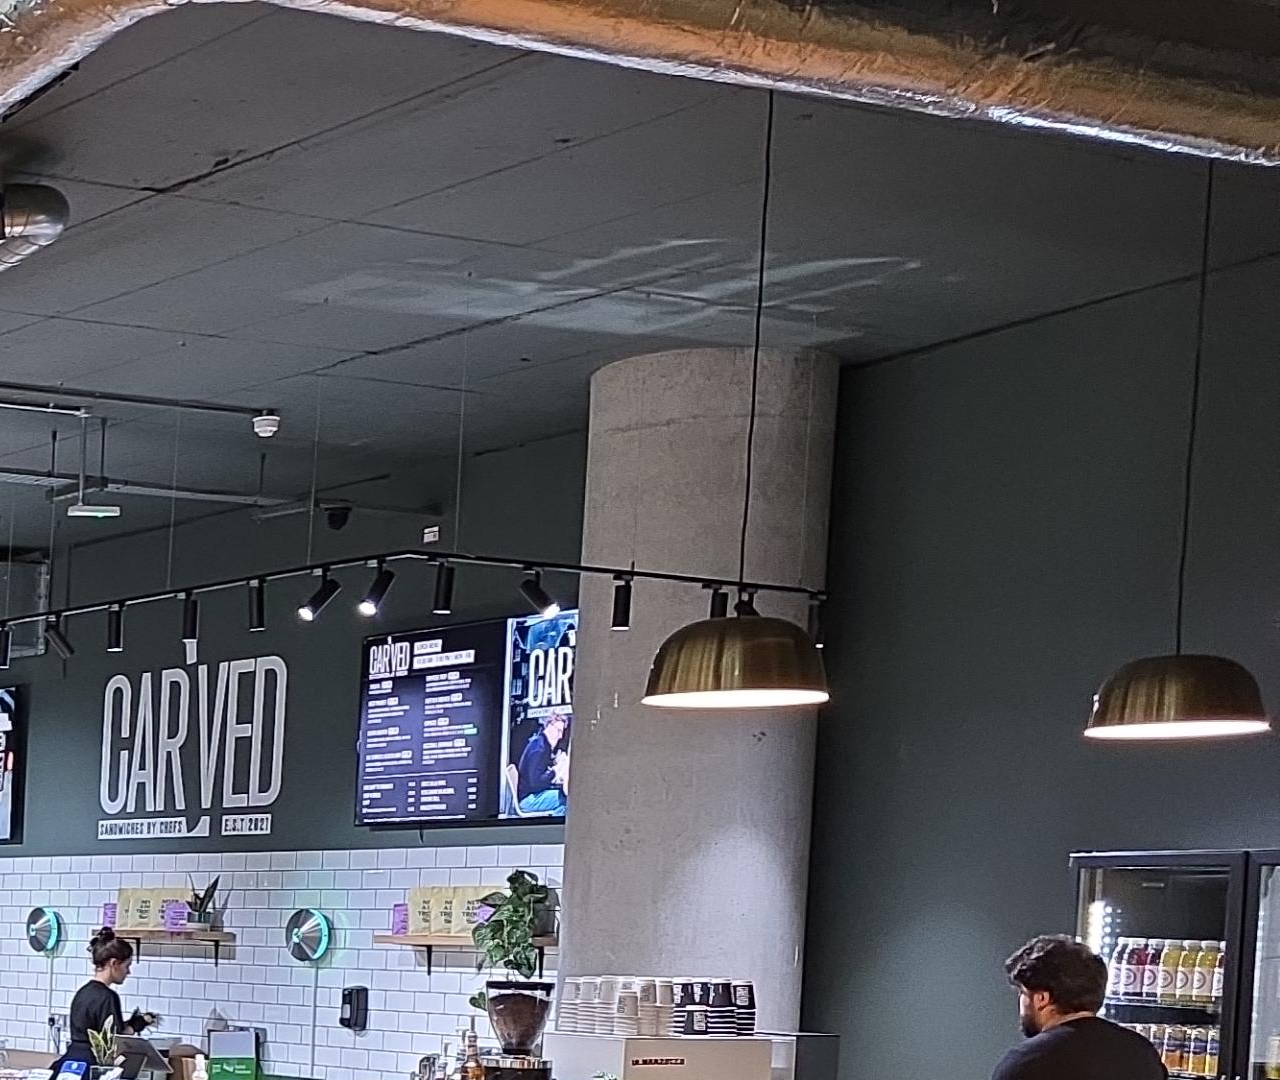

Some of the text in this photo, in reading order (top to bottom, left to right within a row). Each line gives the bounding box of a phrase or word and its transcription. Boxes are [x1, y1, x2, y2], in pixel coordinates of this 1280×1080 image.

[370, 642, 410, 674] CARVED
[99, 655, 287, 815] CARVED
[99, 820, 183, 836] SANDWICHES BY CHEFS
[248, 816, 269, 831] 2021
